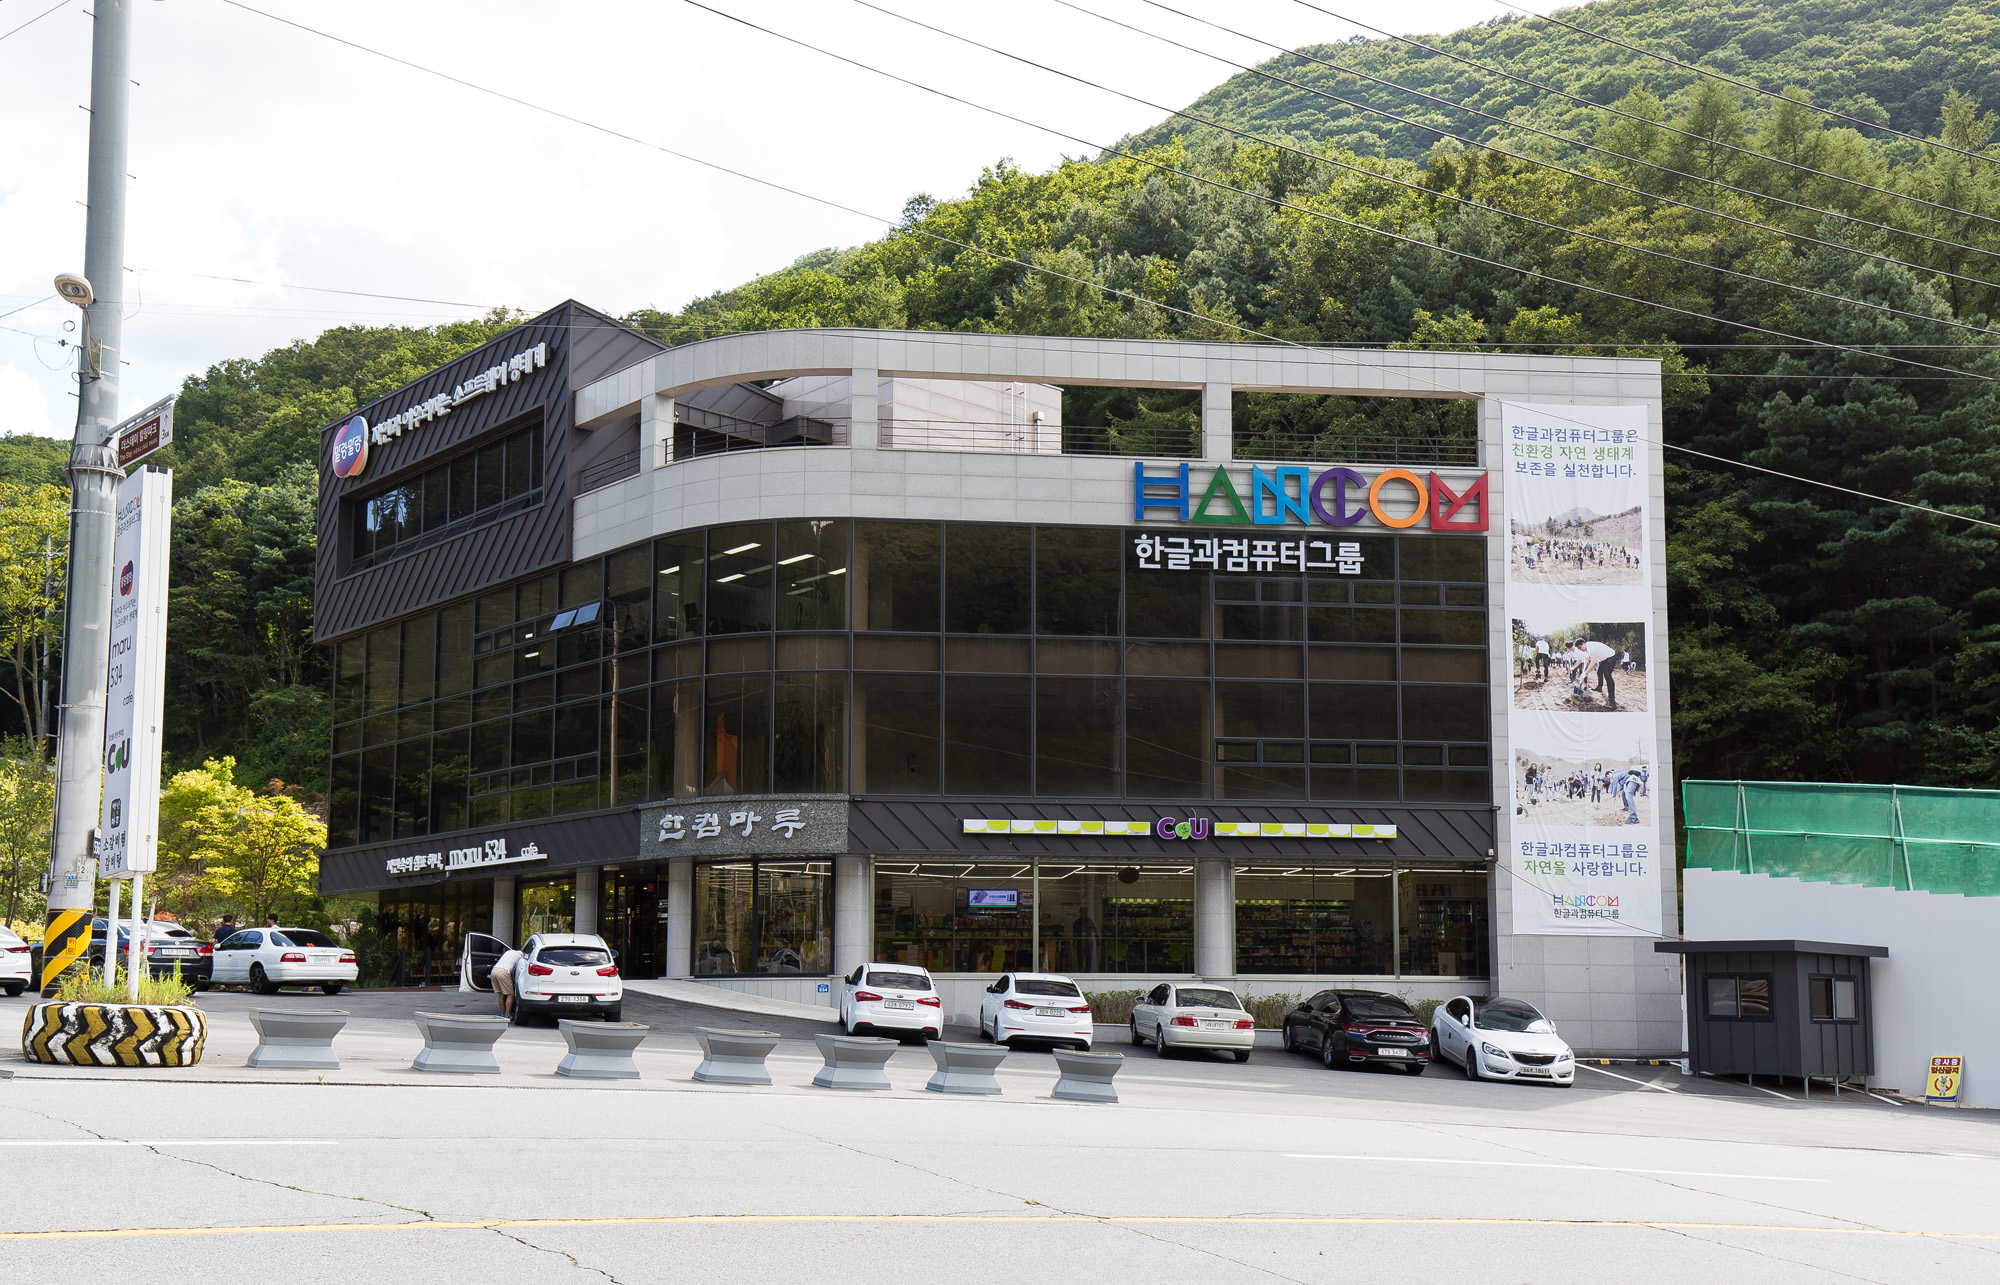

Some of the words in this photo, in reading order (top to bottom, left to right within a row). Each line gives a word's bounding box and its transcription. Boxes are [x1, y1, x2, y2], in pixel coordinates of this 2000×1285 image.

[371, 413, 402, 446] 자연과
[451, 361, 508, 407] 소프트웨어
[507, 341, 546, 382] 생태계
[120, 431, 139, 451] 더스테이
[1511, 424, 1639, 444] 한글과컴퓨터그룹은
[334, 433, 363, 463] 말랑말랑
[1511, 442, 1553, 459] 친환경
[1559, 445, 1587, 461] 자연
[1592, 445, 1634, 462] 생태계
[1514, 461, 1557, 477] 보존을
[1562, 463, 1637, 478] 실천합니다.
[1134, 461, 1490, 532] HANCOM
[1134, 533, 1365, 575] 한글과컴퓨터그룹
[111, 634, 132, 660] maru
[110, 662, 123, 688] 534
[122, 690, 134, 707] cafe
[107, 737, 131, 775] CU
[658, 808, 806, 843] 한컴마루
[1156, 816, 1209, 840] CU
[103, 830, 126, 851] 소갈비찜
[1520, 841, 1649, 859] 한글과컴퓨터그룹은
[104, 850, 122, 872] 갈비탕
[449, 846, 482, 867] maru
[484, 838, 507, 862] 534
[520, 841, 539, 858] cafe
[1524, 859, 1567, 876] 자연을
[1571, 861, 1647, 877] 사랑합니다.
[1553, 894, 1619, 907] HANCOM
[1553, 908, 1620, 919] 한글과컴퓨터그룹
